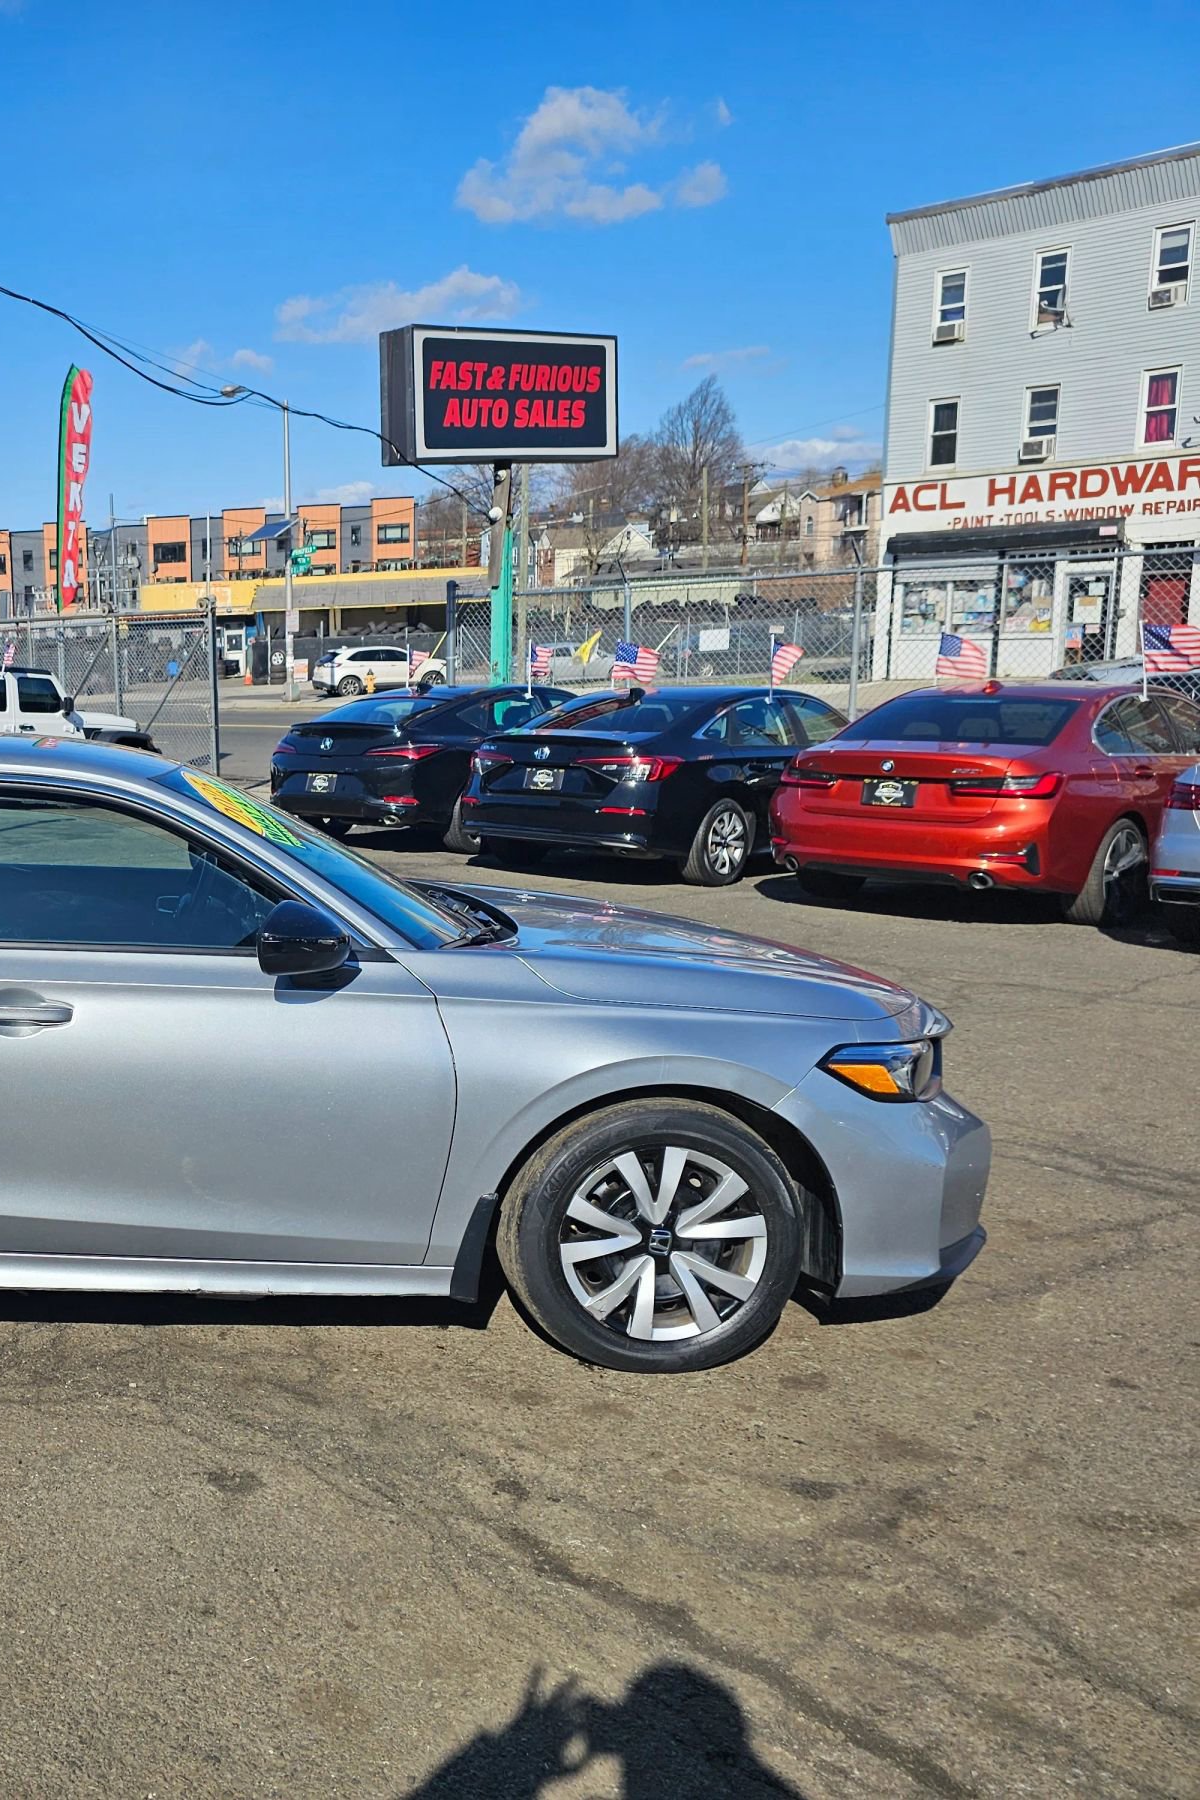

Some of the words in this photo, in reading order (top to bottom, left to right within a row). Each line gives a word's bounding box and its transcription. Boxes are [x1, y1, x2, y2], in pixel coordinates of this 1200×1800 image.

[429, 361, 488, 390] FAST
[486, 365, 506, 391] &
[508, 363, 601, 393] FURIOUS
[443, 398, 509, 428] AUTO
[513, 399, 586, 428] SALES
[889, 483, 965, 514] ACL
[1064, 504, 1134, 521] WINDOW
